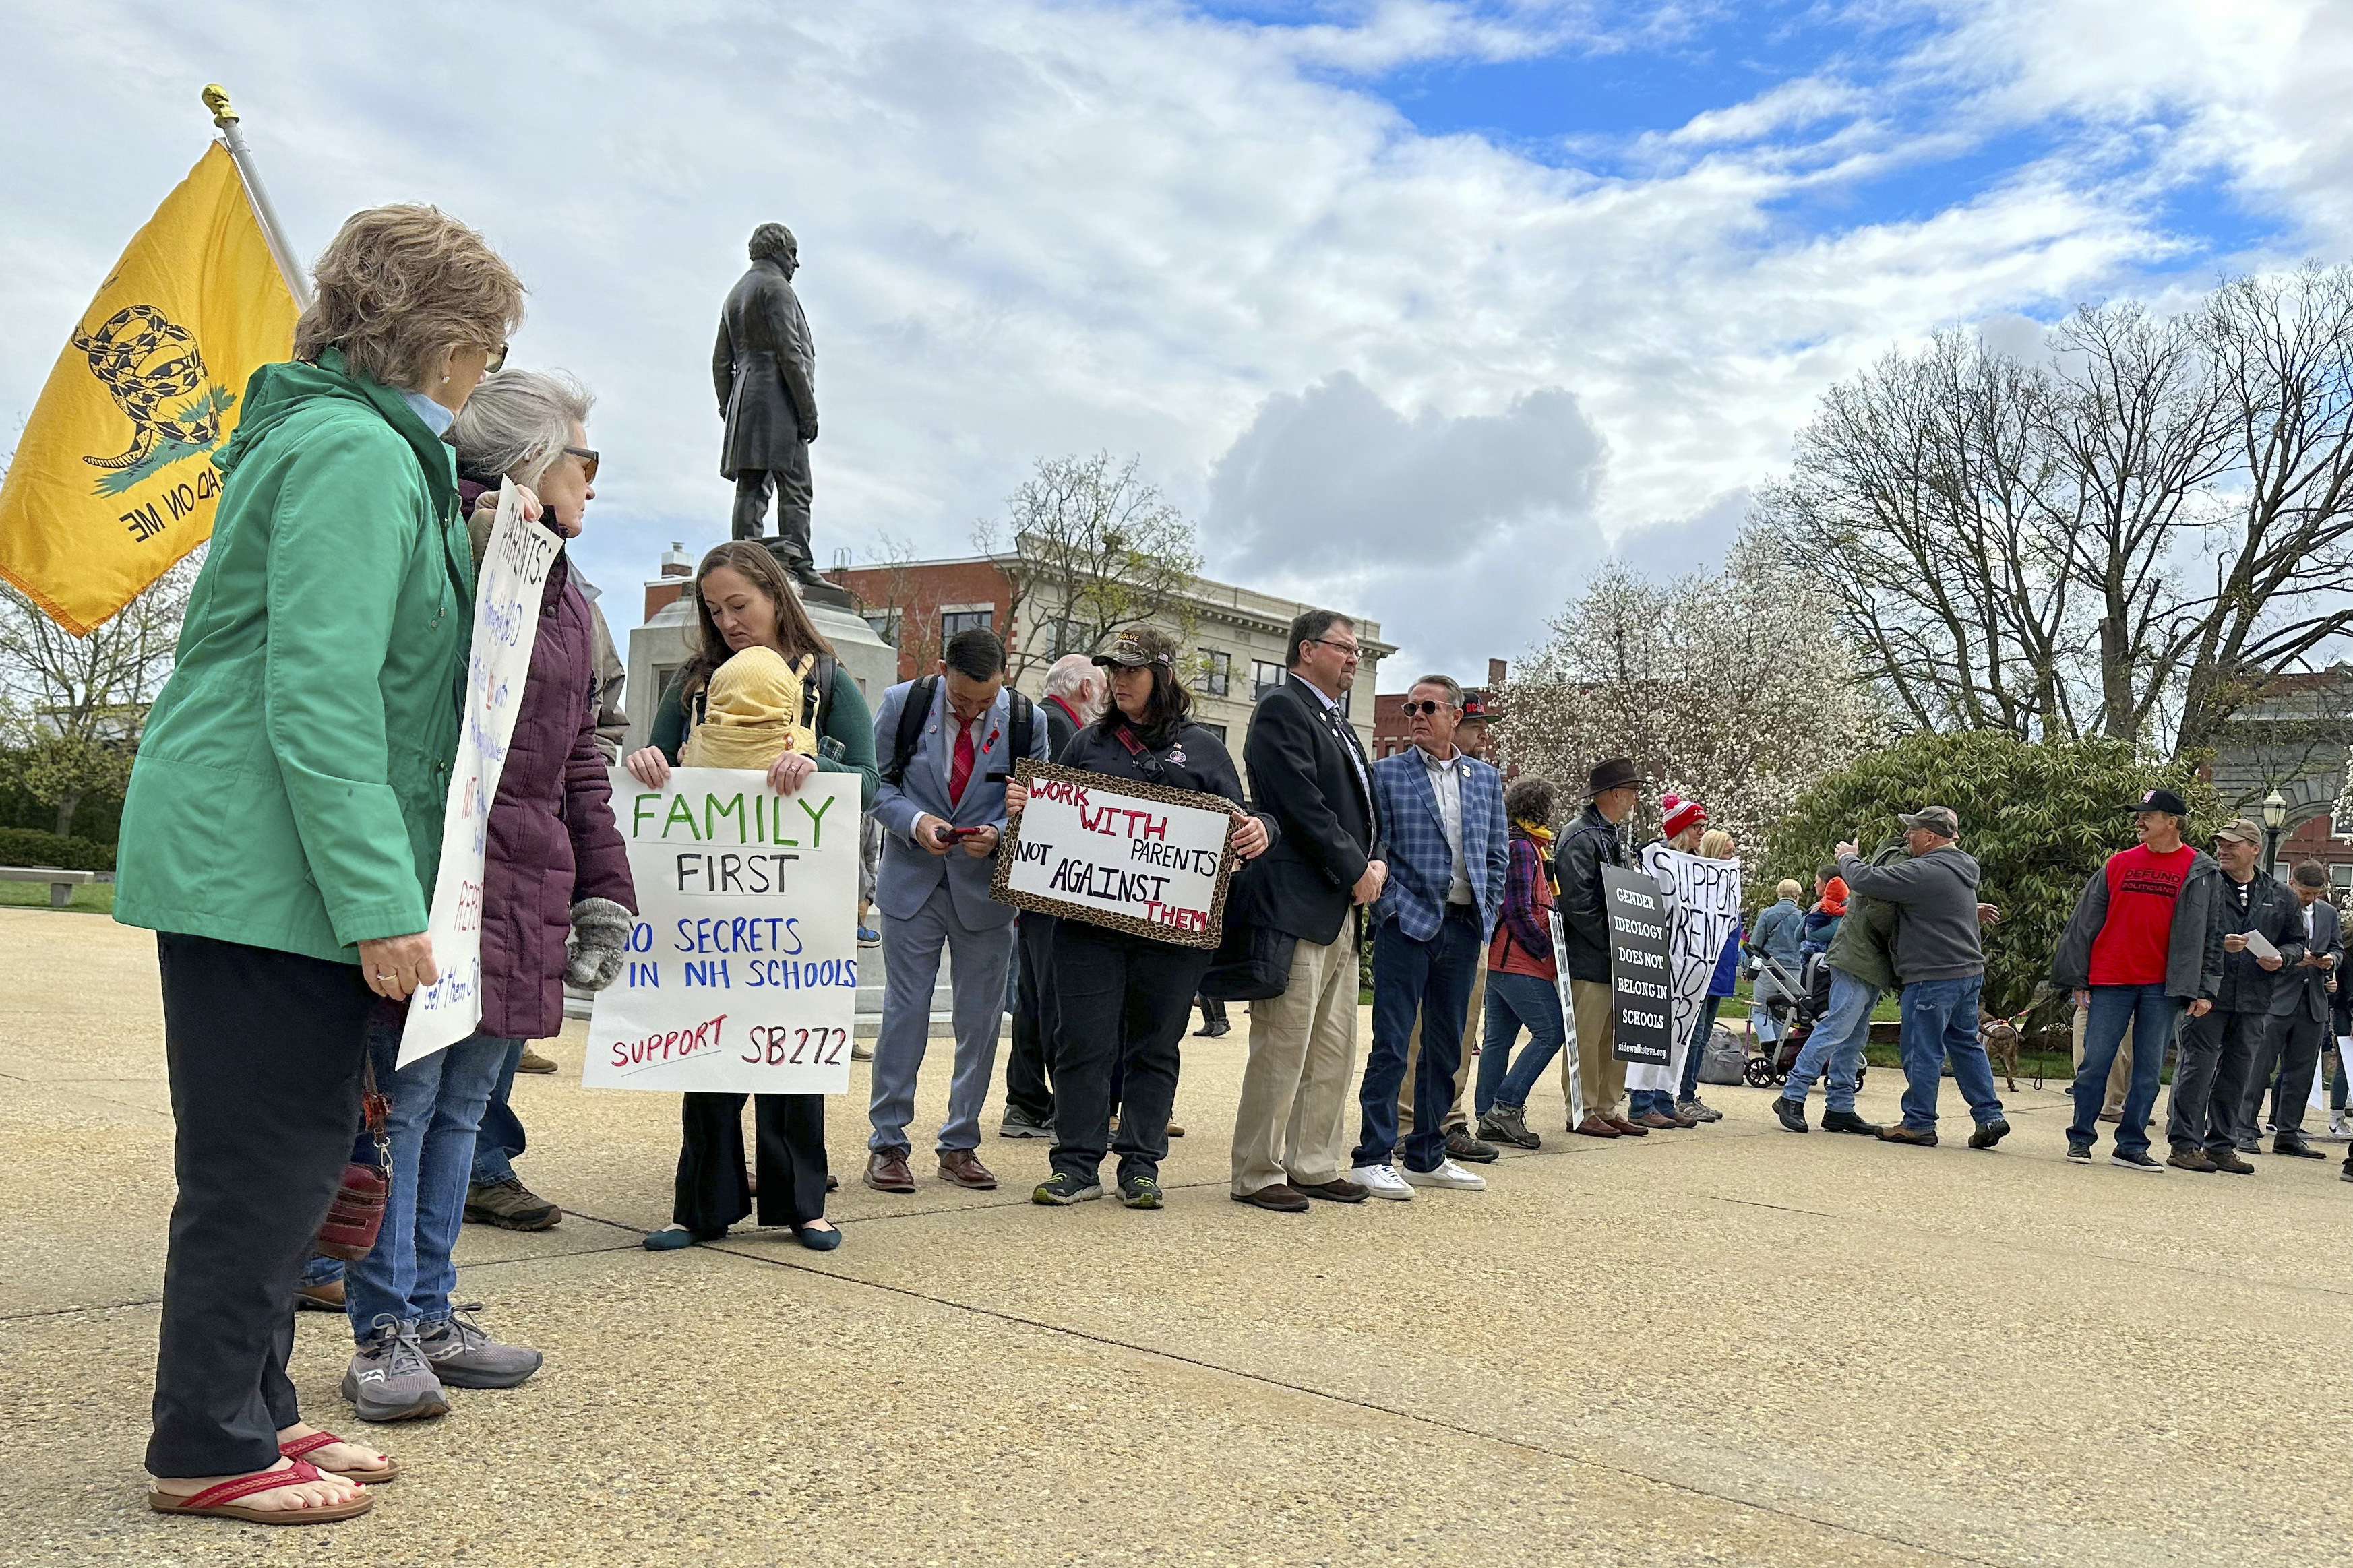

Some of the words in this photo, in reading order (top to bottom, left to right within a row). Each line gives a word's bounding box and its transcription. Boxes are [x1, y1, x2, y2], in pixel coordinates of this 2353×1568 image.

[1029, 776, 1090, 807] WORK
[633, 792, 836, 848] FAMILY
[1080, 804, 1167, 842] WITH
[1014, 839, 1053, 866] NOT
[1130, 838, 1218, 877] PARENTS
[677, 853, 800, 894] FIRST
[1049, 857, 1171, 902] AGAINST
[2121, 883, 2176, 895] POLITICIANS
[2124, 869, 2182, 885] DEFUND
[1616, 887, 1655, 910] GENDER
[1143, 900, 1207, 933] THEM
[1614, 916, 1663, 941] IDEOLOGY
[675, 916, 803, 955] SECRETS
[1618, 946, 1643, 966] DOES
[1645, 954, 1664, 970] NOT
[629, 960, 659, 989] IN
[685, 958, 731, 989] NH
[745, 958, 857, 990] SCHOOLS
[1617, 977, 1655, 997] BELONG
[1656, 984, 1668, 1000] IN
[1622, 1009, 1664, 1030] SCHOOLS
[611, 1013, 728, 1067] SUPPORT
[1618, 1041, 1667, 1060] sidewalksteve.org
